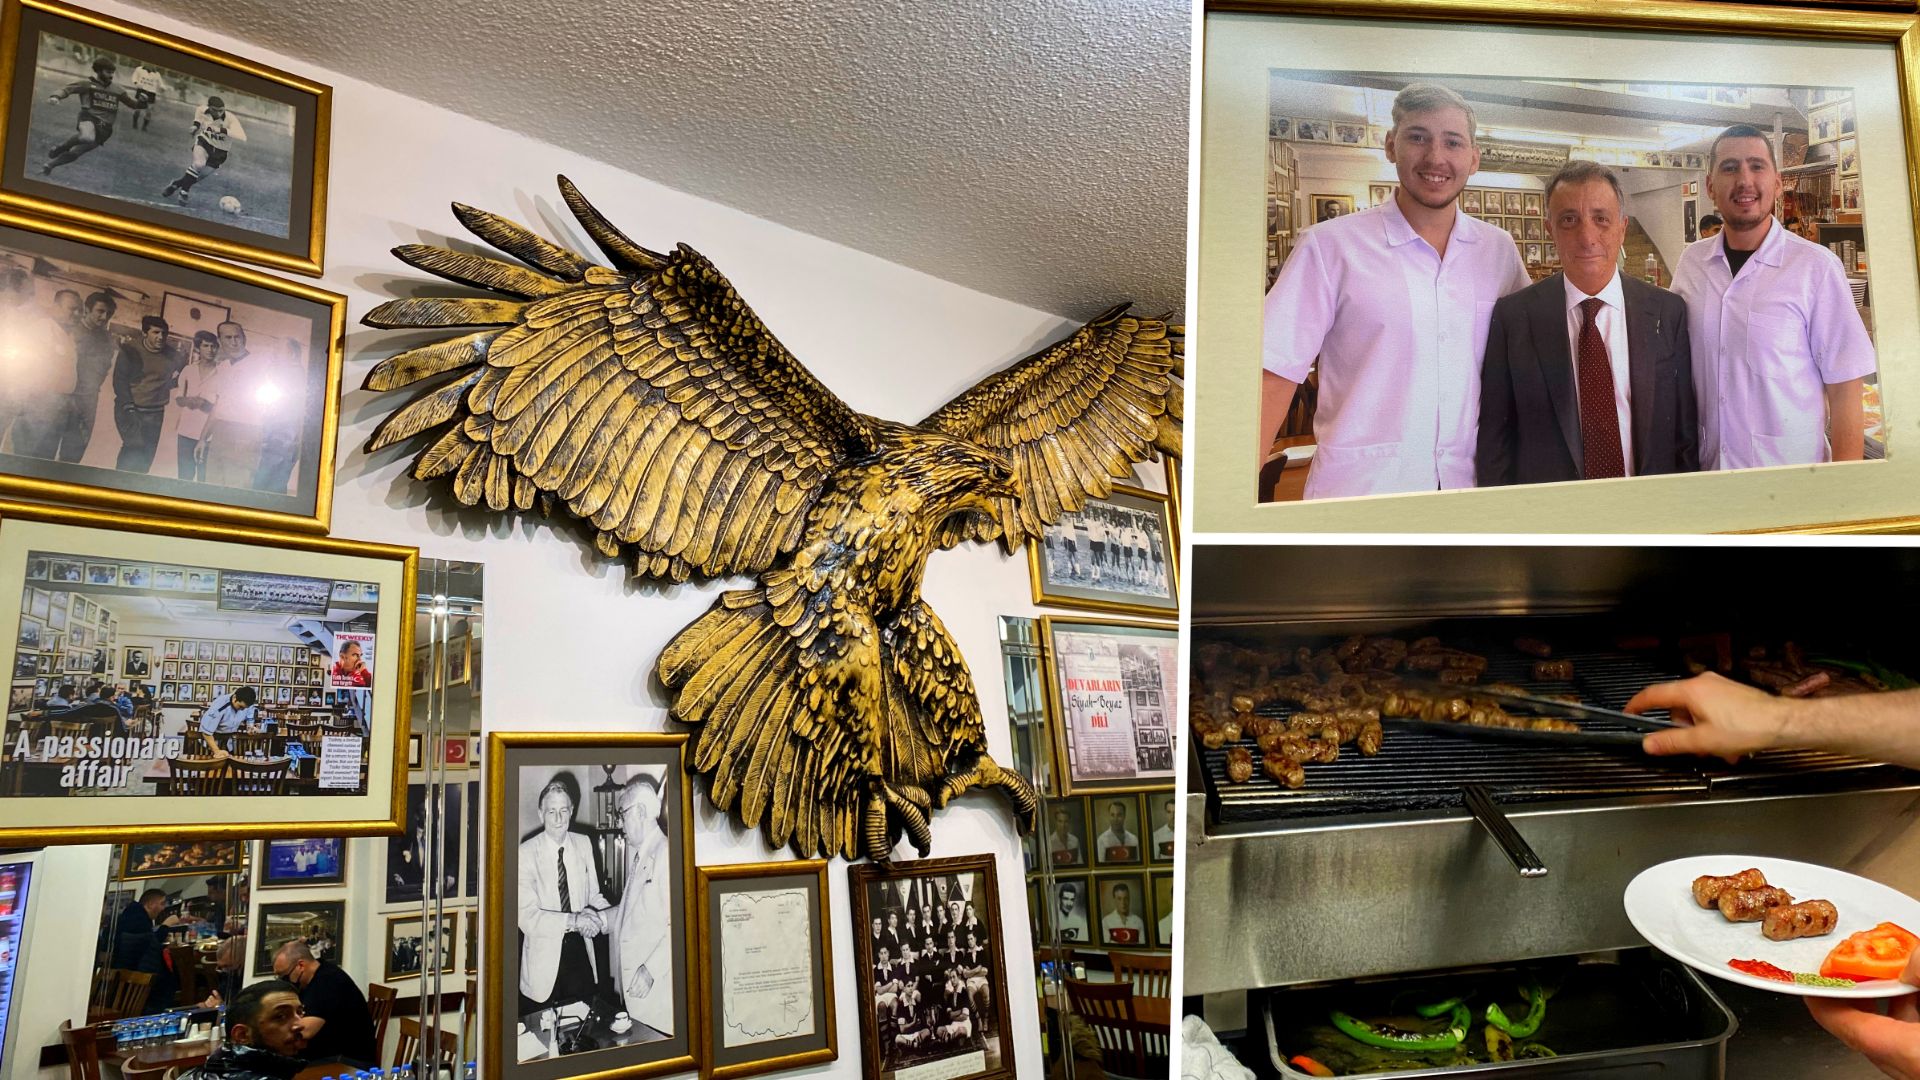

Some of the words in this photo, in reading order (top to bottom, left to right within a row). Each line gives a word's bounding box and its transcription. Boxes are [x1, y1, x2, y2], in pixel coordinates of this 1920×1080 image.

[1067, 679, 1121, 692] DUVARLARIN
[1071, 694, 1122, 713] Siyah-Beyaz
[12, 730, 31, 758] A
[42, 730, 182, 762] passionate
[60, 759, 134, 788] affair
